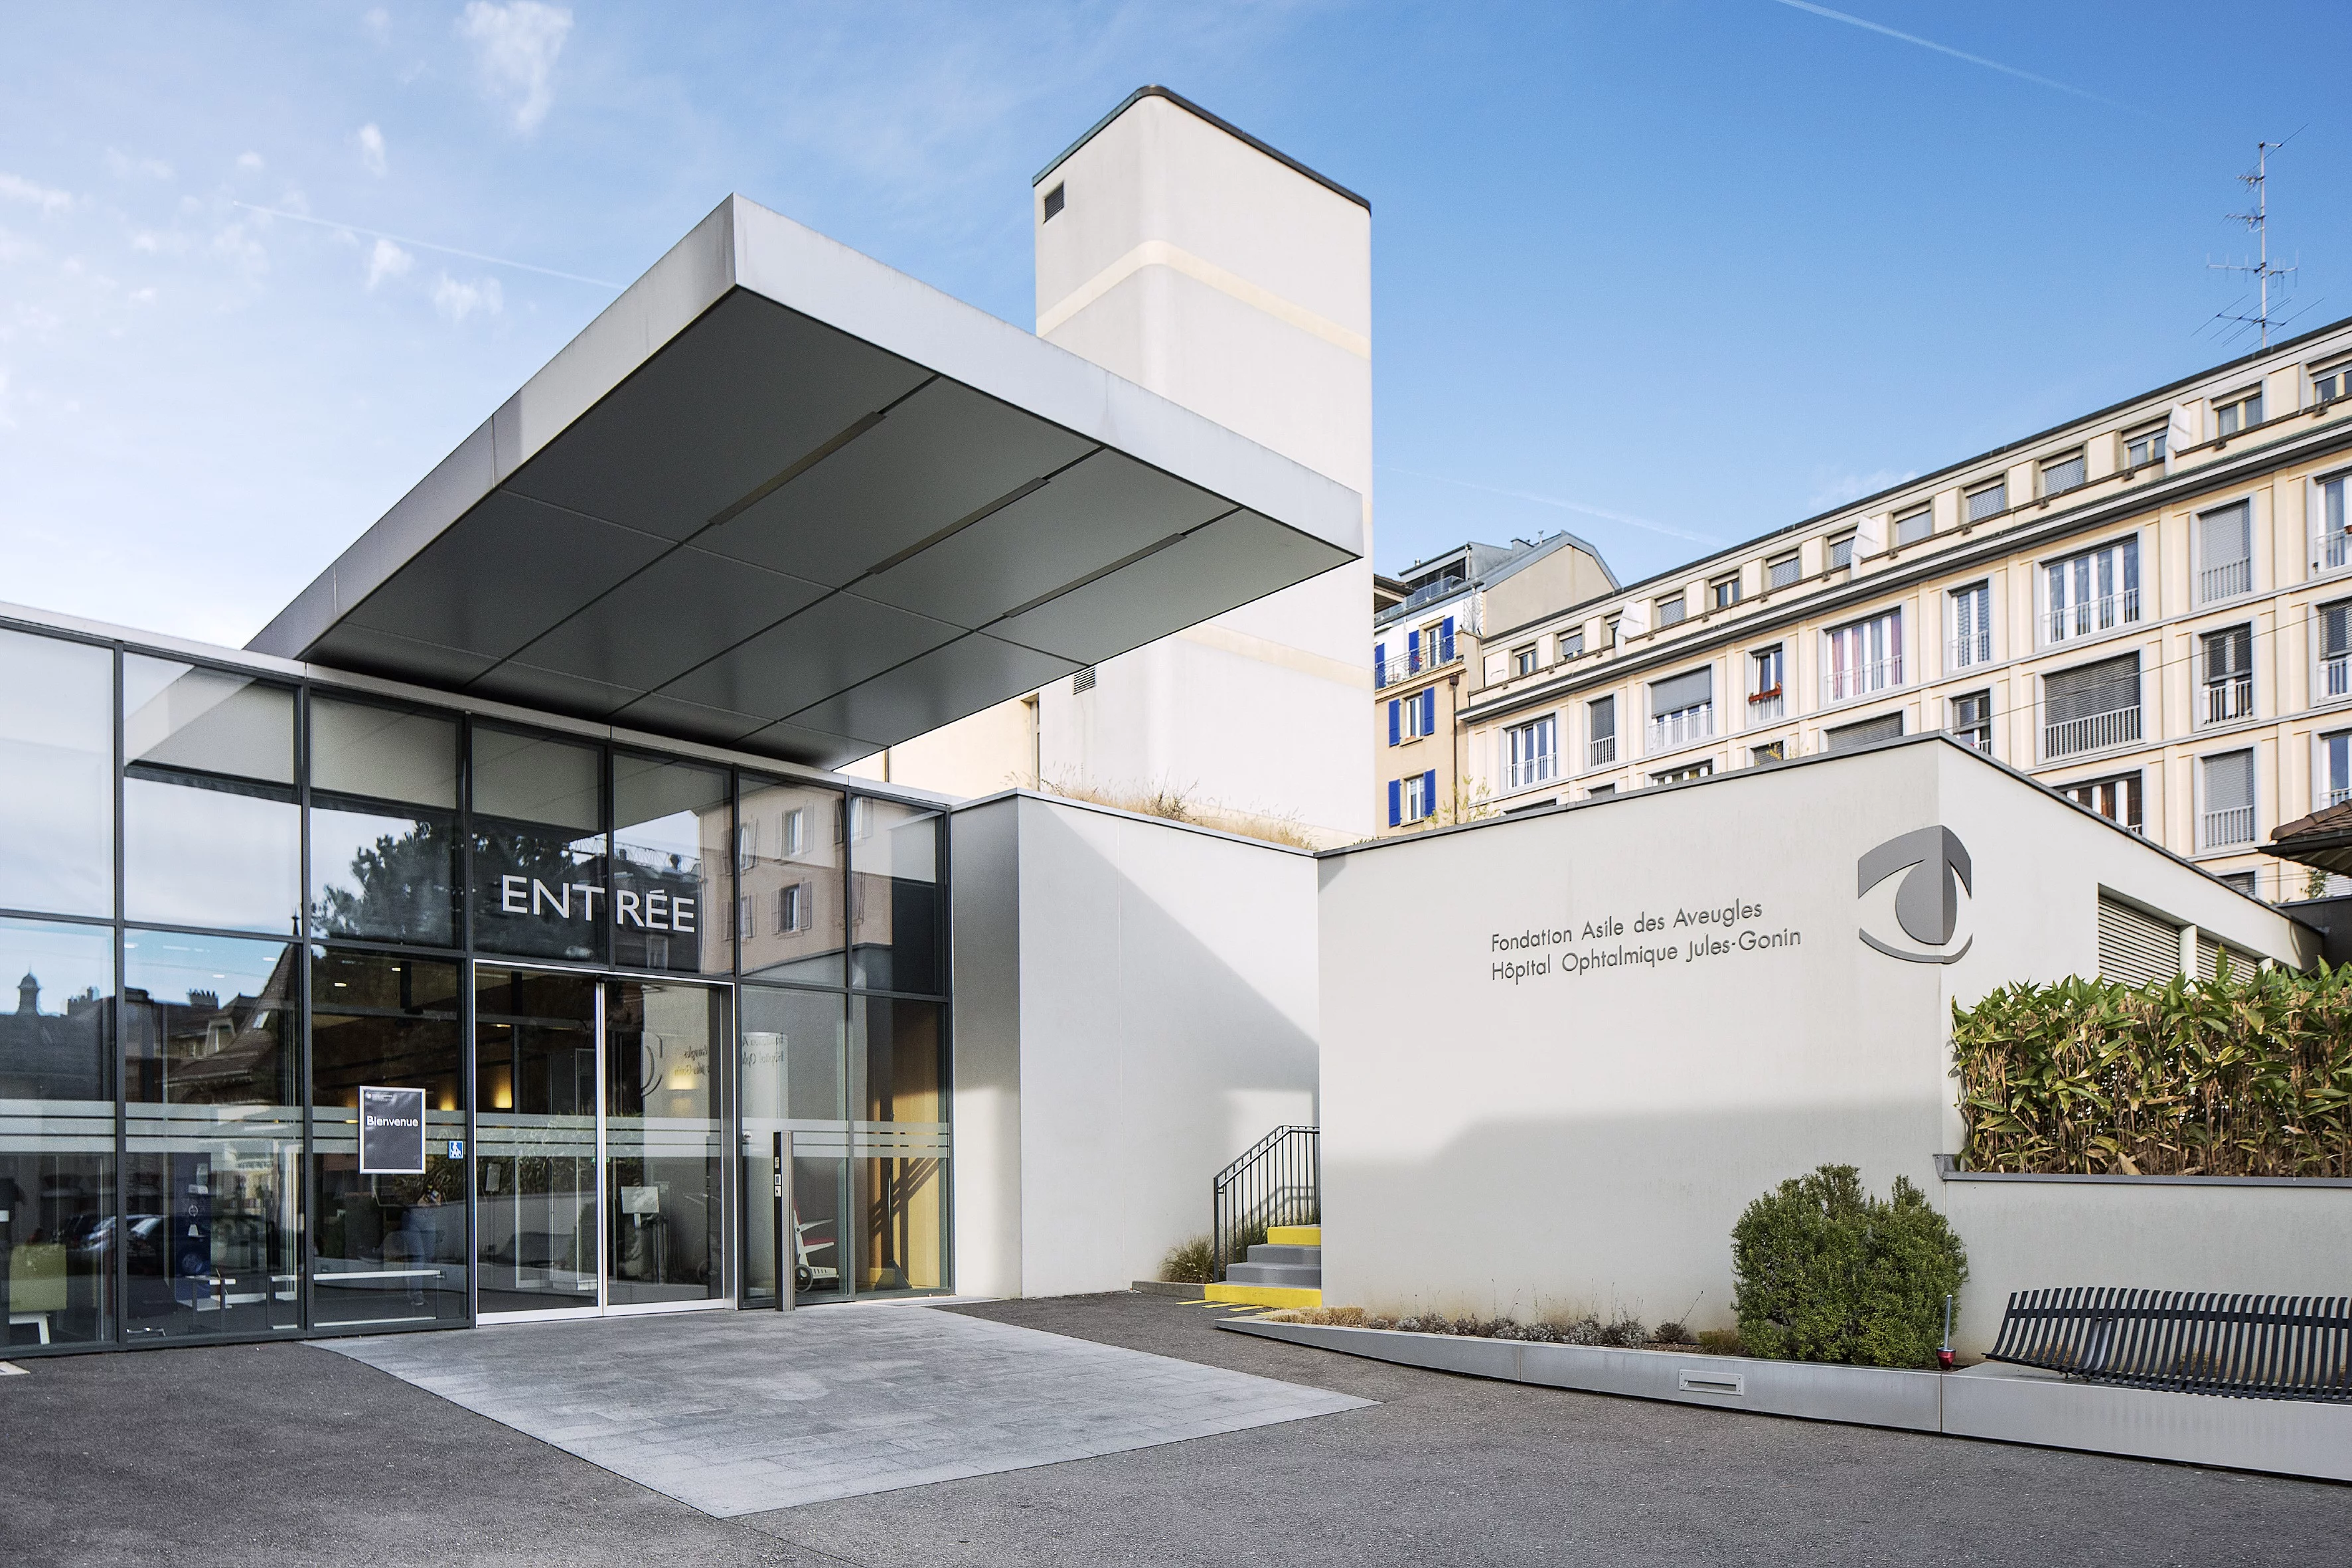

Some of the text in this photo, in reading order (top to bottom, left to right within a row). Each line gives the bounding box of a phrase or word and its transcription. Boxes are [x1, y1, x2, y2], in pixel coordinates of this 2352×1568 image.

[502, 875, 695, 933] ENTRÉE
[1492, 898, 1763, 952] Fondation Asile des Aveugles
[1492, 928, 1802, 985] Hôpital Ophtalmique Jules-Gonin
[366, 1115, 419, 1127] Bienvenue
